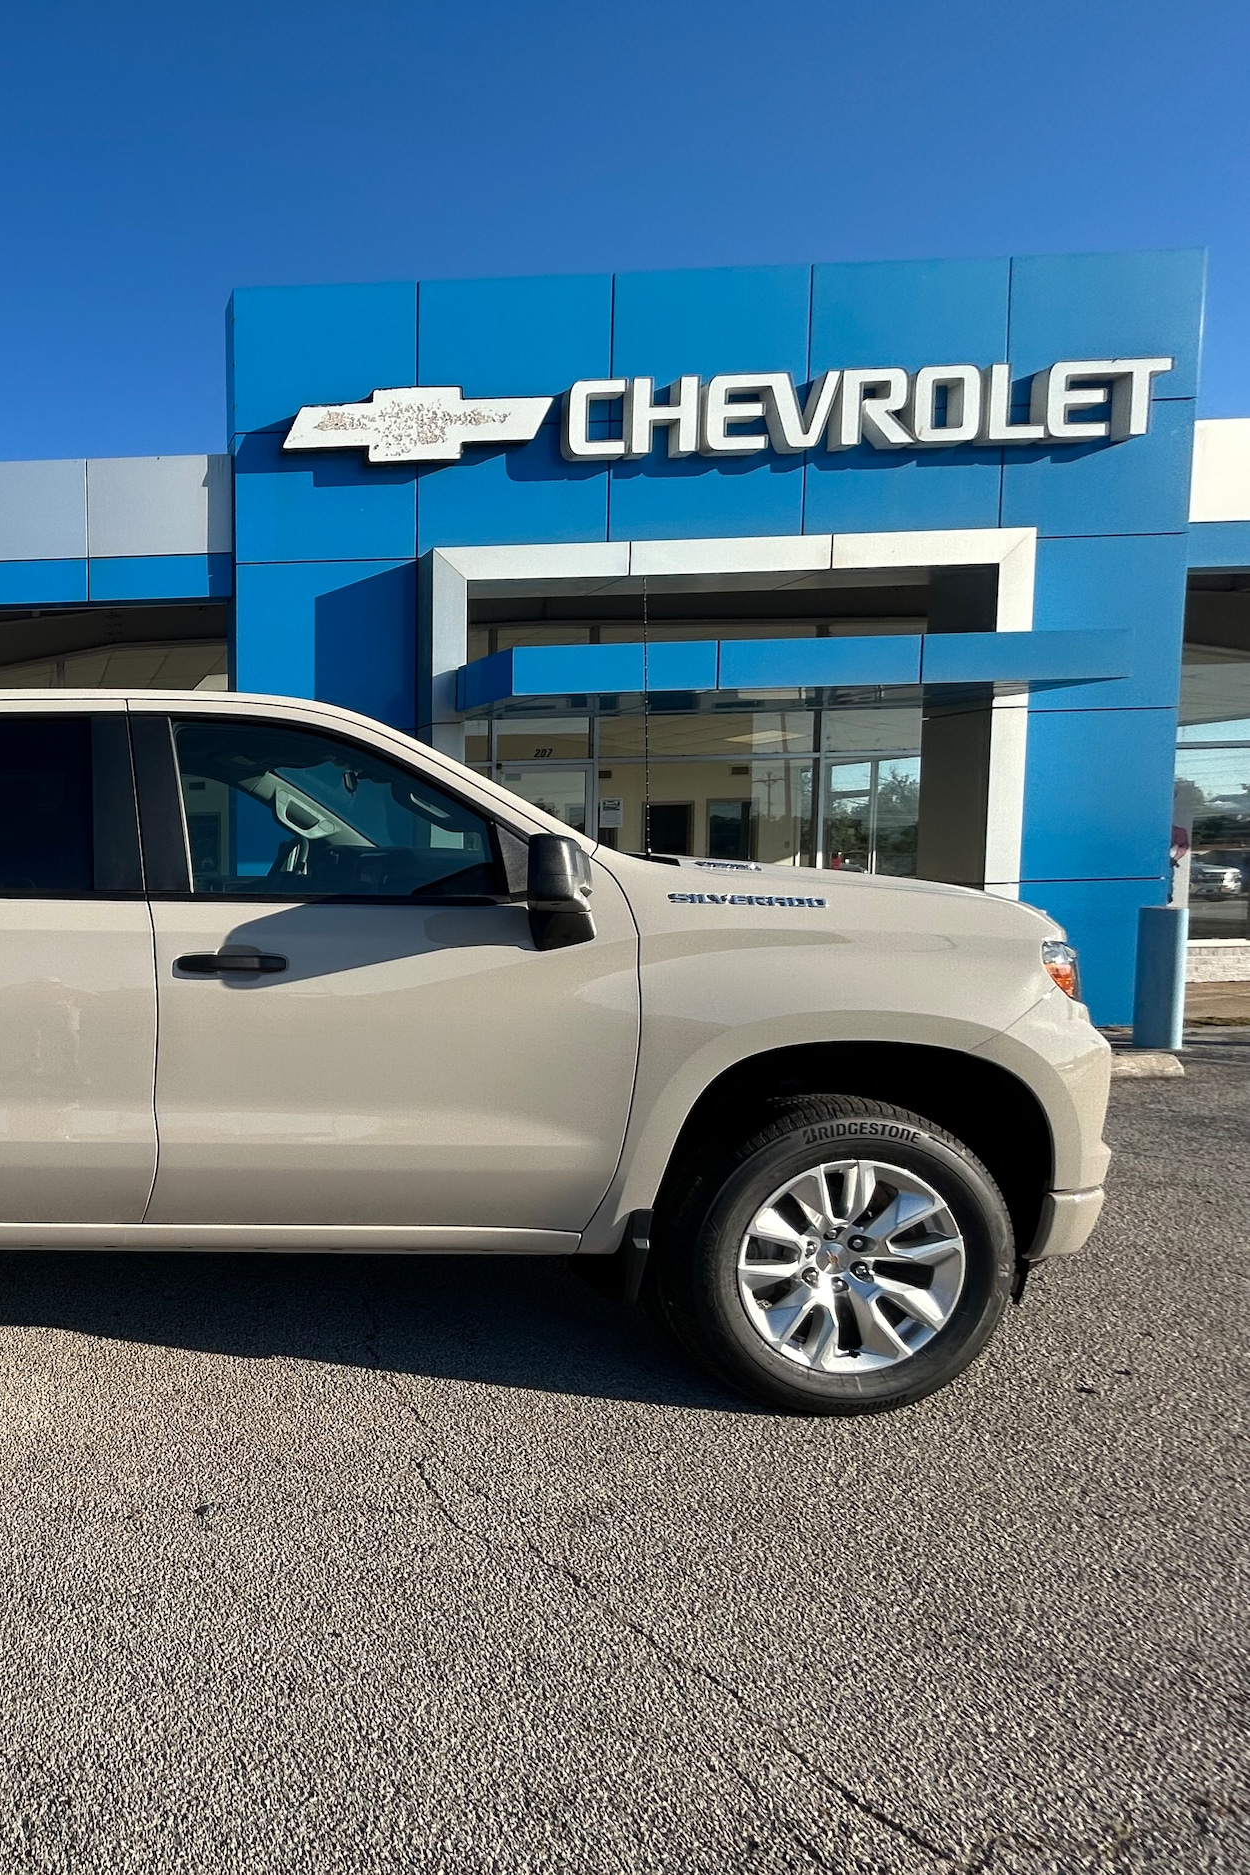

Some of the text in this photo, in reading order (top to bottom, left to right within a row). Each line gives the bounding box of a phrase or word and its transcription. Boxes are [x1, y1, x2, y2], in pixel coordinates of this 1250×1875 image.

[561, 356, 1174, 462] CHEVROLET
[533, 748, 553, 758] 207
[666, 892, 829, 908] SILVERADO
[802, 1121, 922, 1145] BRIDGESTONE
